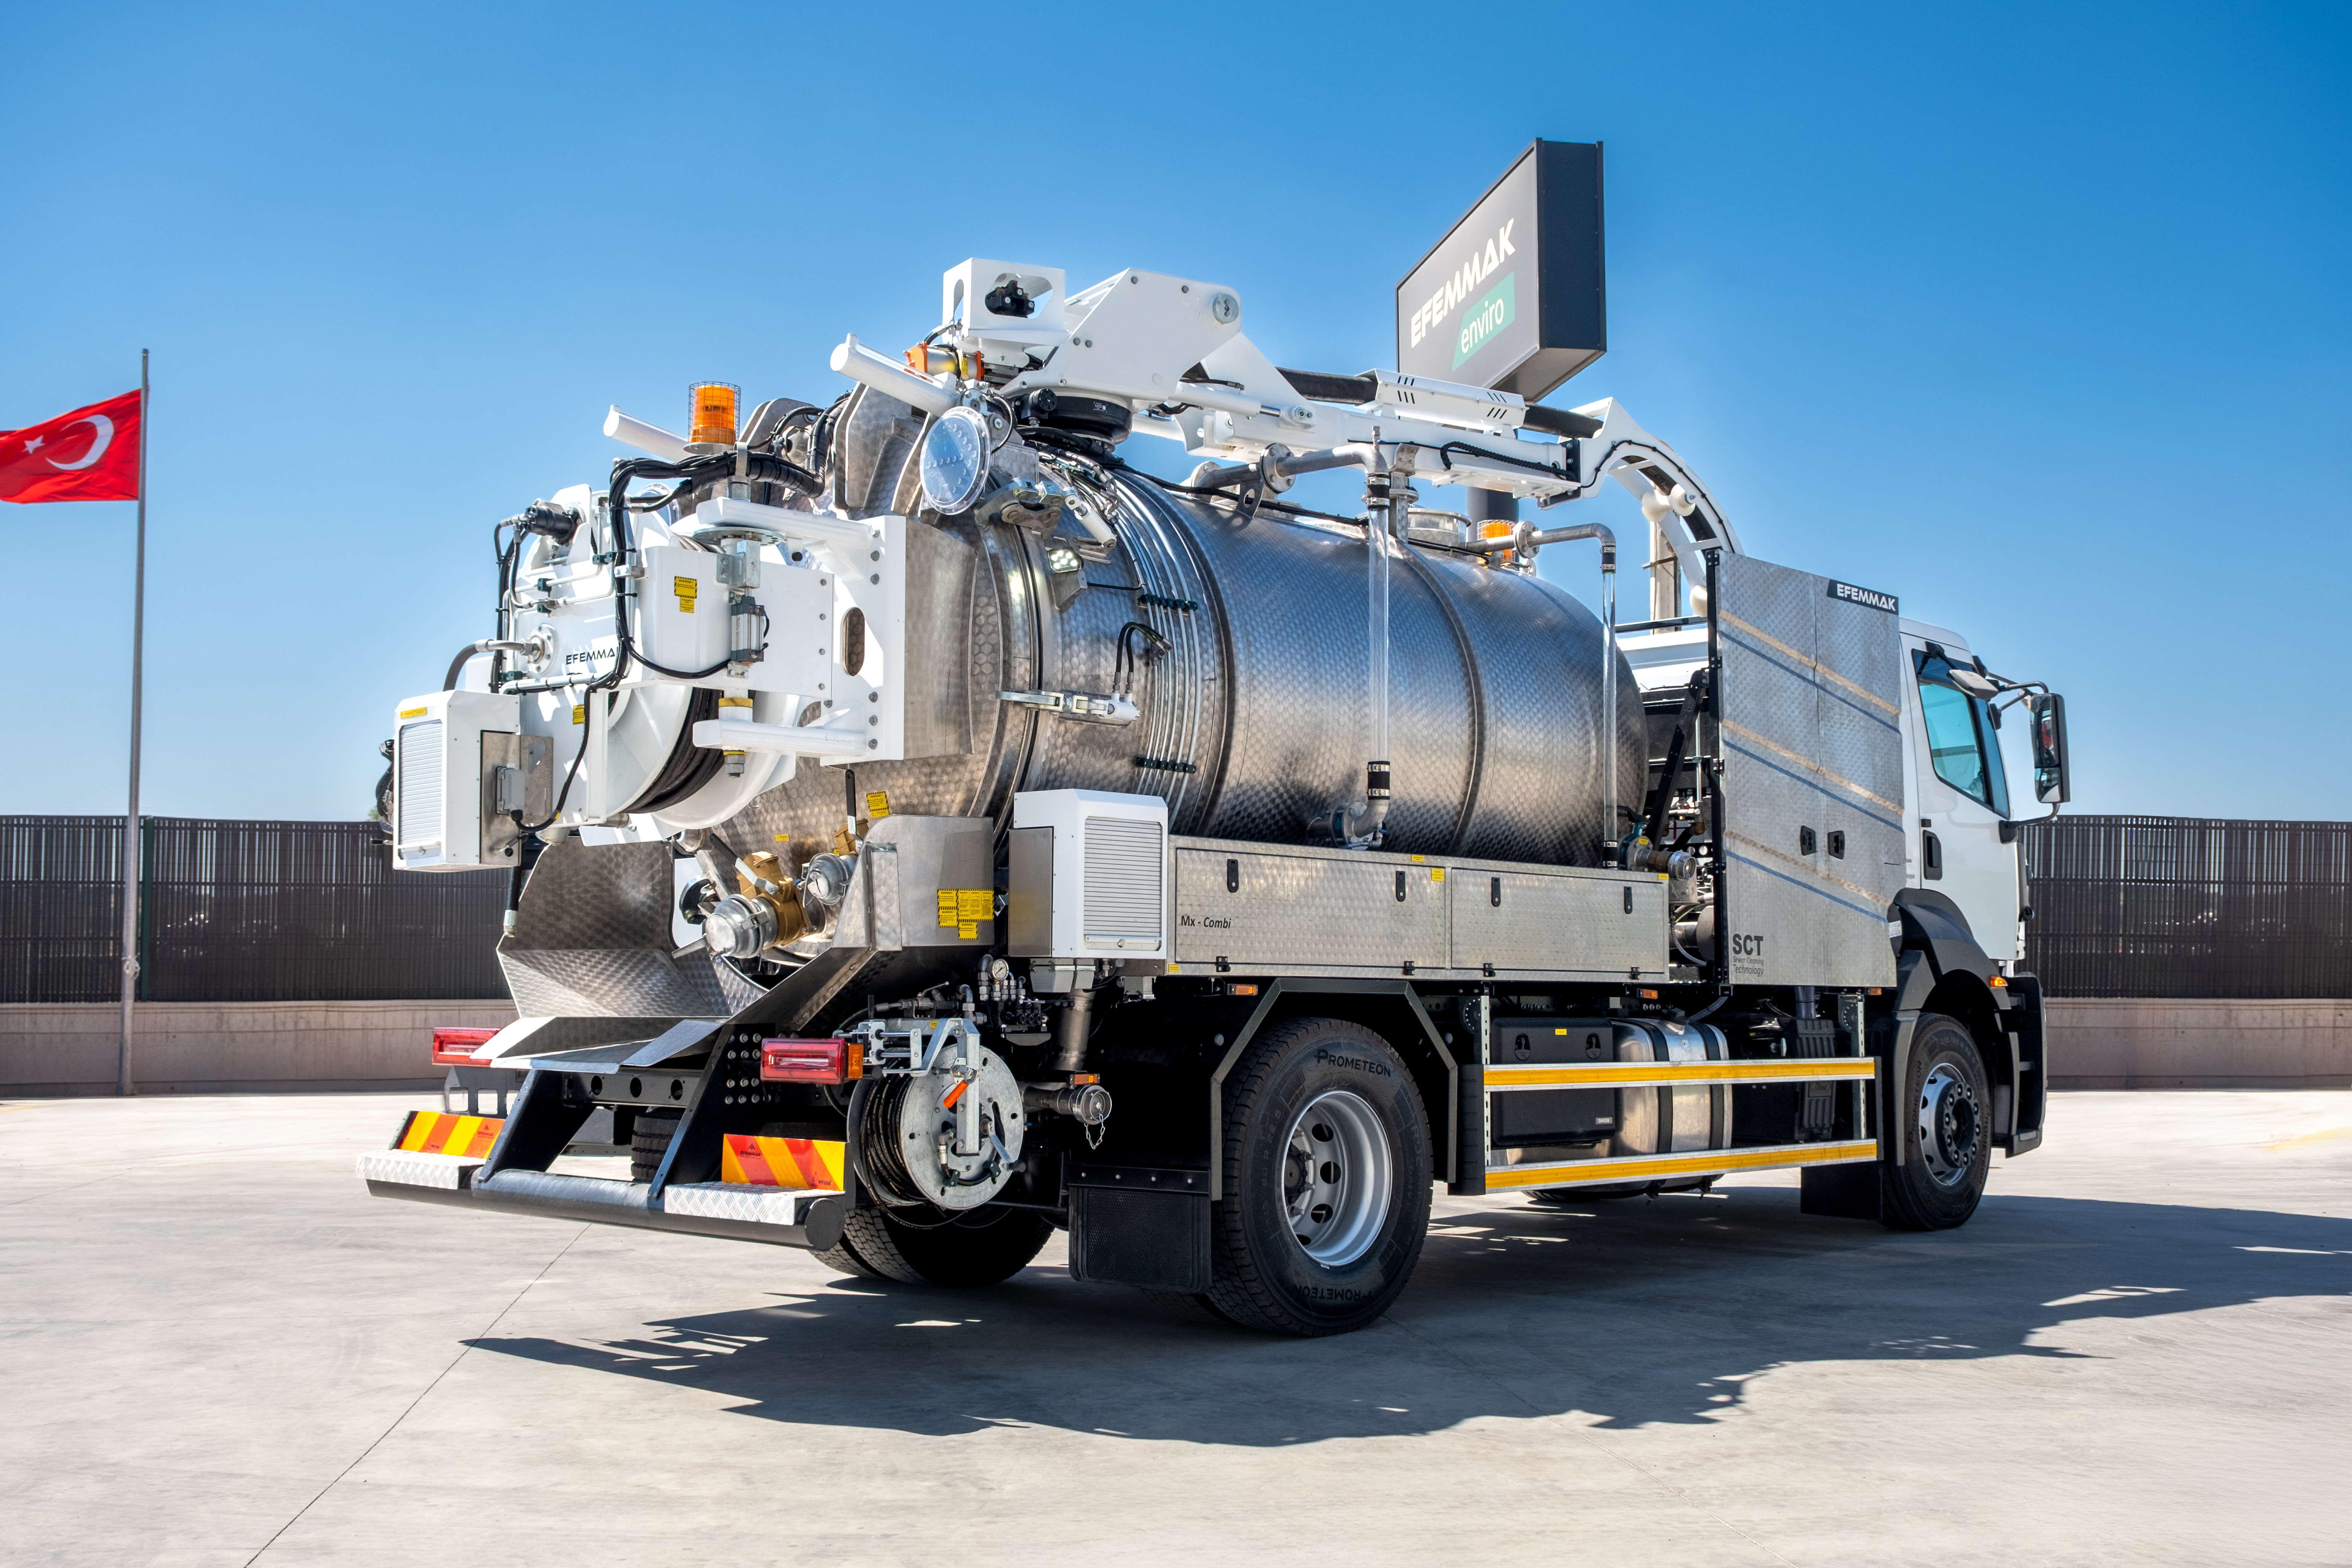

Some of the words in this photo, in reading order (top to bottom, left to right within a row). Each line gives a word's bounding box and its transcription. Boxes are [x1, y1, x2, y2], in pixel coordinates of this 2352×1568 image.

[1411, 218, 1516, 348] EFEMMAK
[1461, 298, 1504, 354] enviro
[1836, 583, 1896, 611] EFEMMAK
[1181, 916, 1195, 926] Mx
[1204, 917, 1231, 928] Combi
[1733, 933, 1763, 956] SCT
[1732, 964, 1764, 977] Technology
[1746, 957, 1764, 966] Cleaning
[1314, 1049, 1391, 1078] PROMETEON
